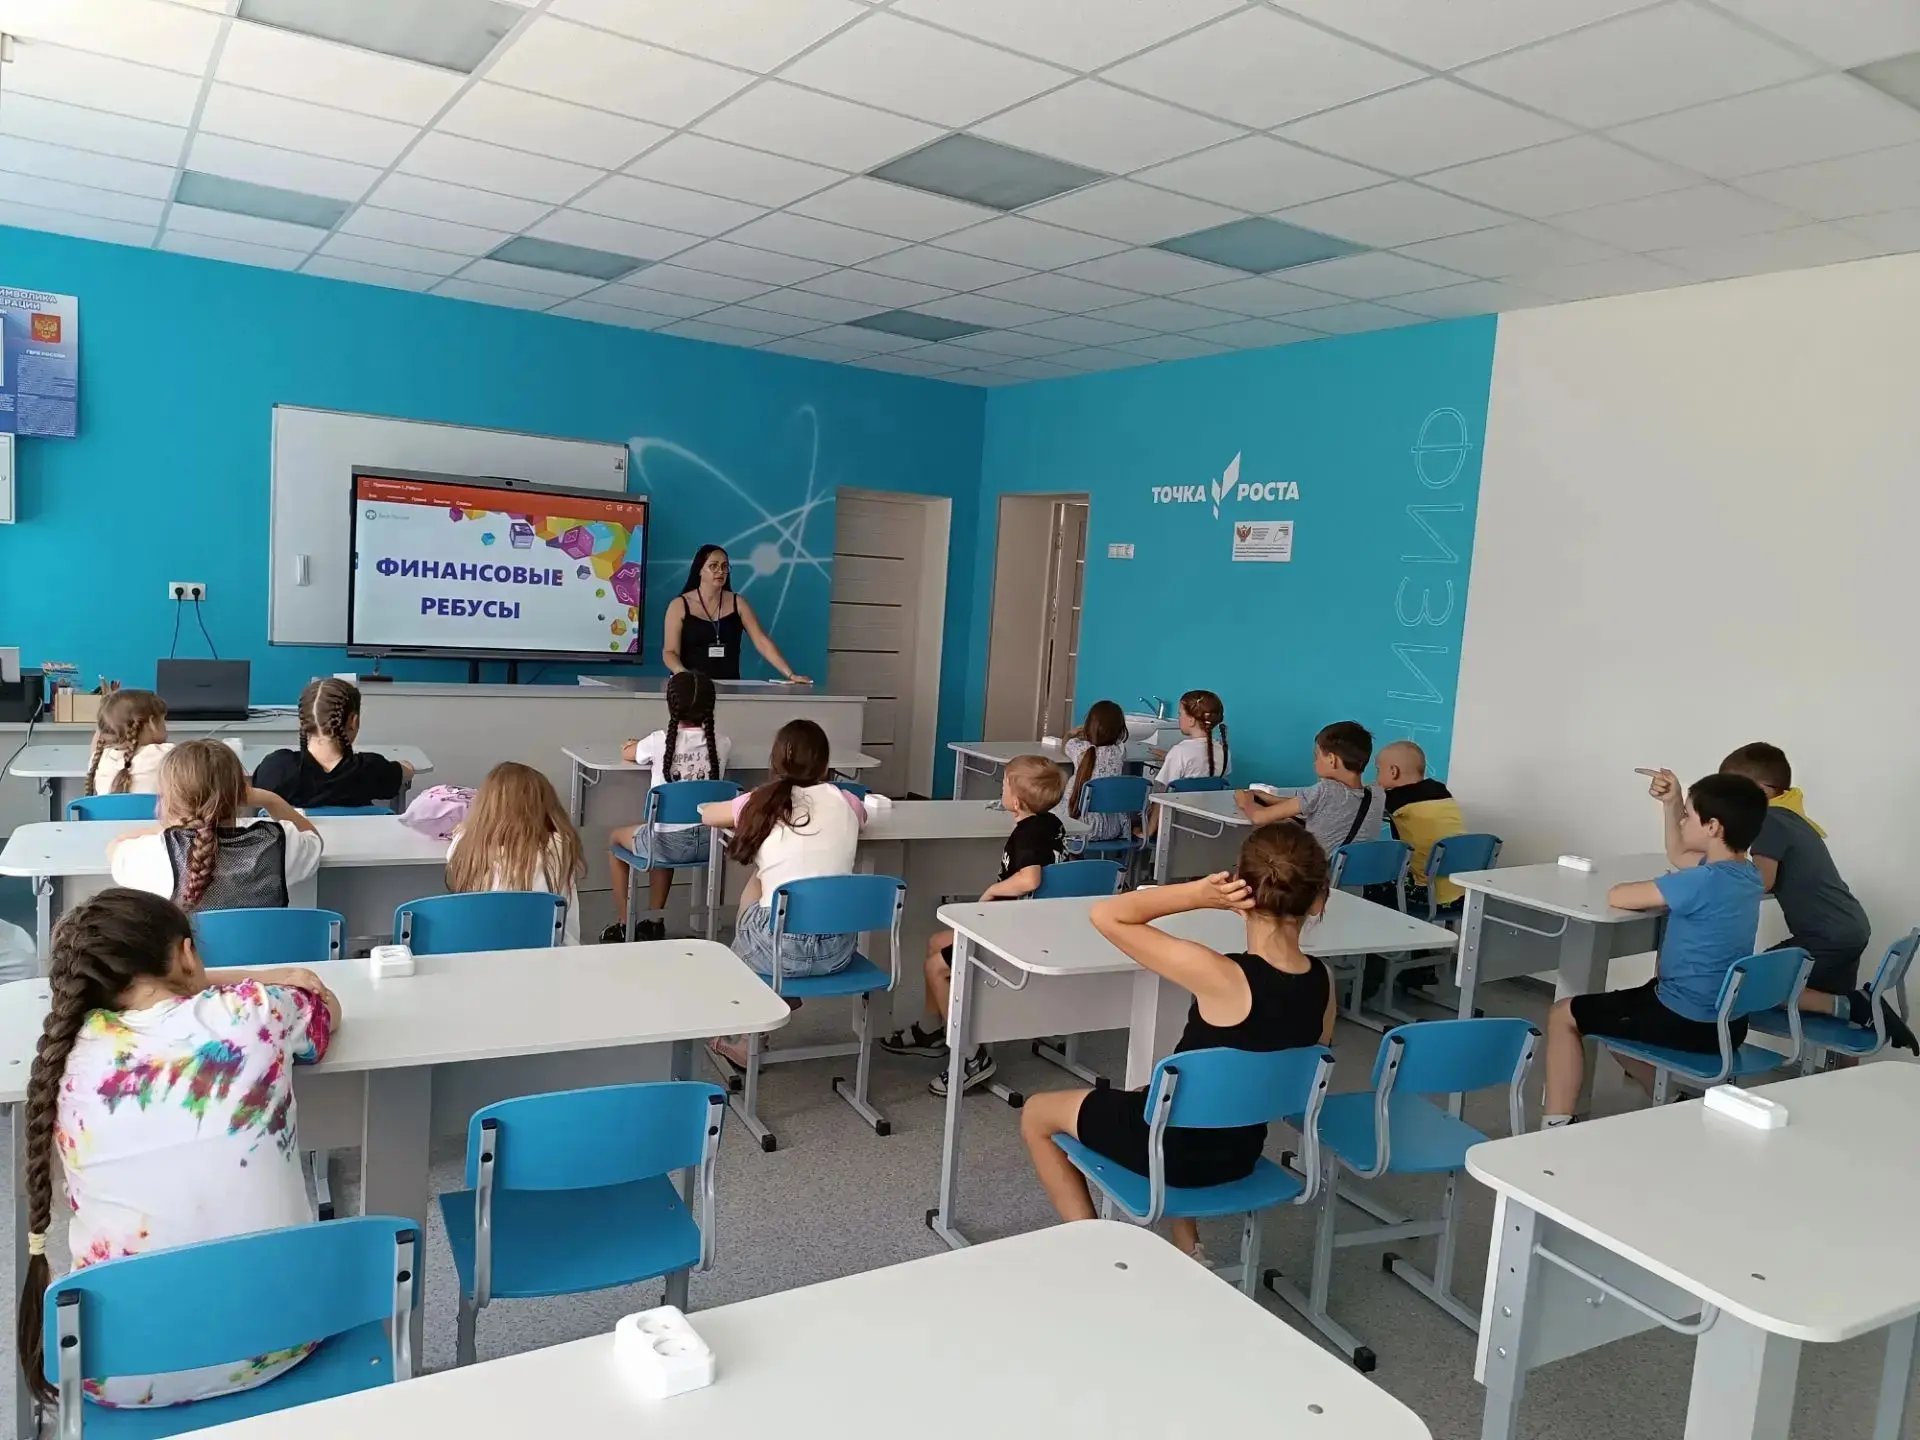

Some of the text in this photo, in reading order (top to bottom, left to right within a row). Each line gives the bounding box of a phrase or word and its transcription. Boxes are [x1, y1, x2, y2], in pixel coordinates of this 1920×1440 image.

[1152, 481, 1300, 503] ТОЧКА РОСТА
[376, 557, 564, 587] ФИНАНСОВЫЕ
[421, 597, 520, 619] РЕБУСЫ
